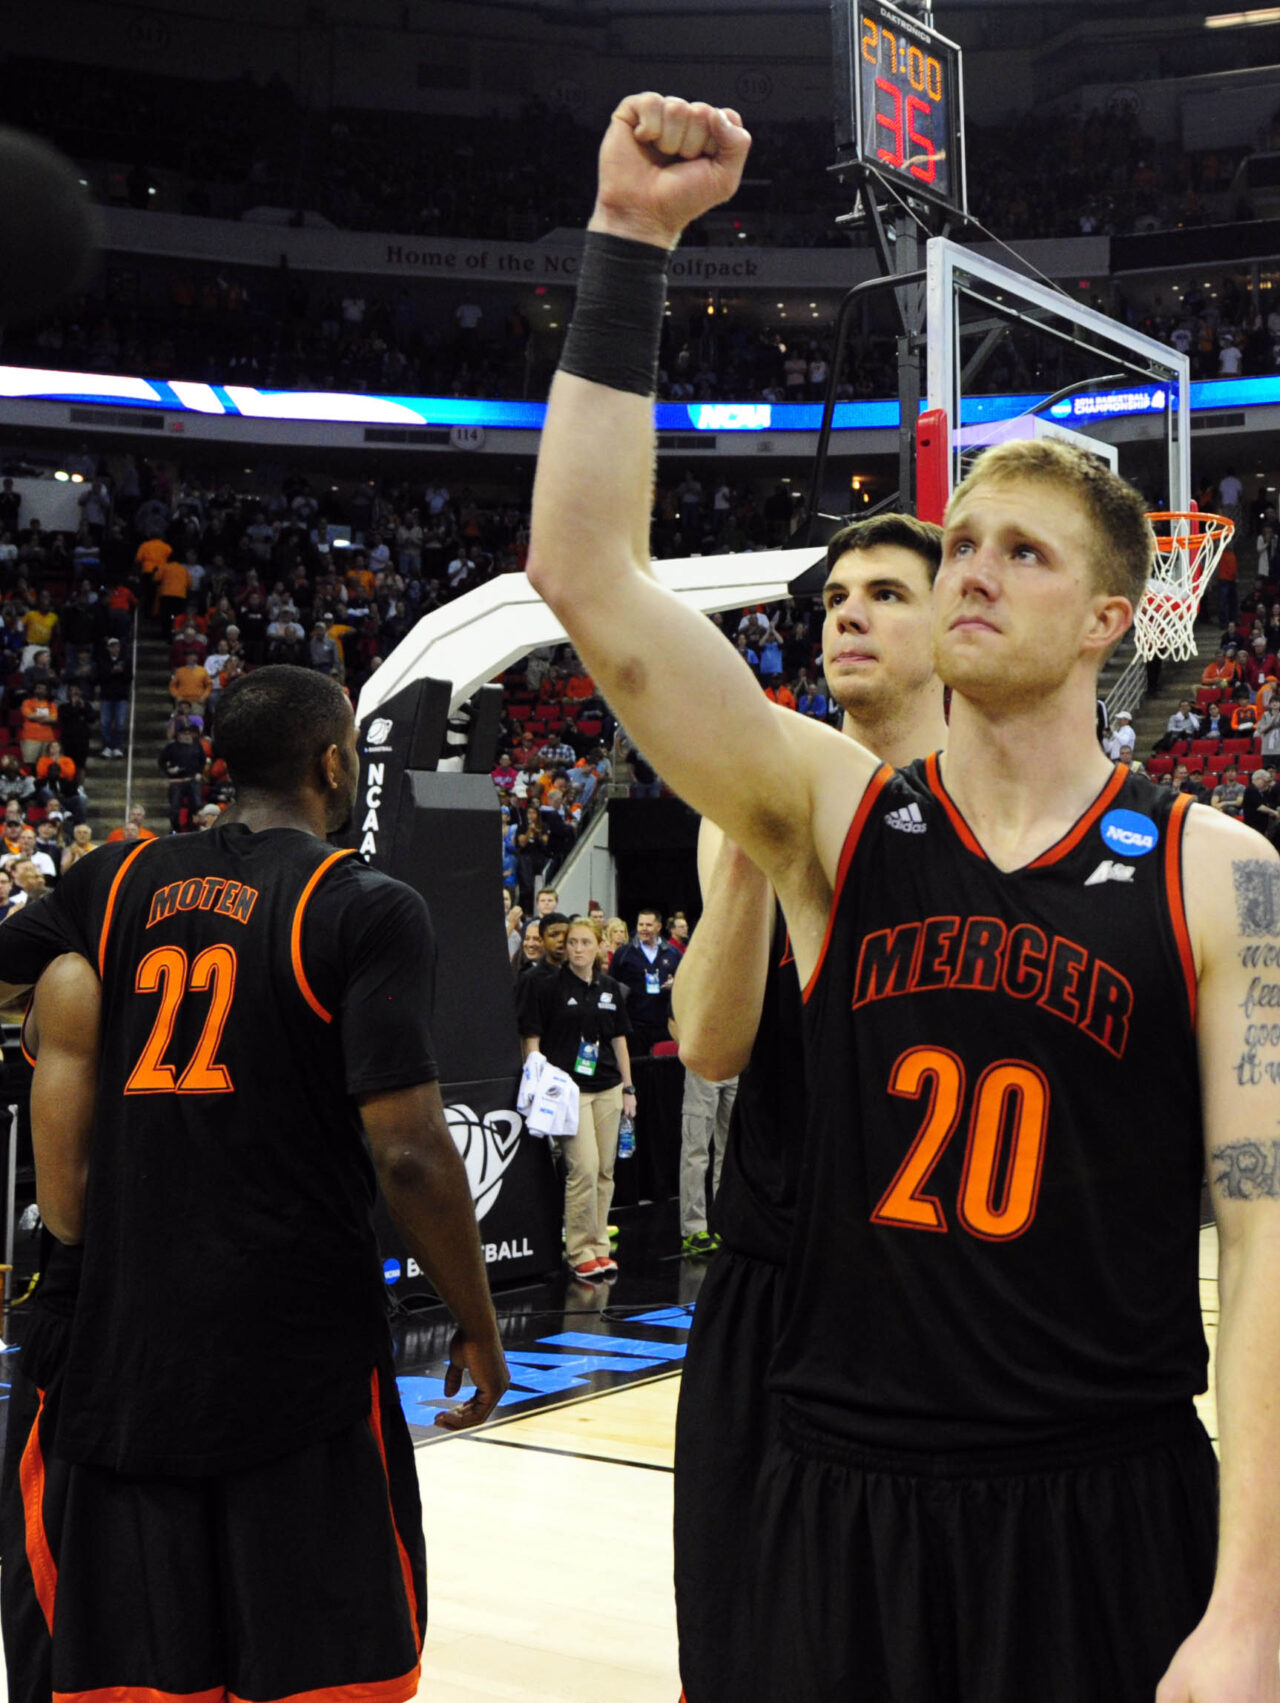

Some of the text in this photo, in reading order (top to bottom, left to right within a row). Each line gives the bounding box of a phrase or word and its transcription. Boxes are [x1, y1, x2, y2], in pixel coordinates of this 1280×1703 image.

[879, 8, 932, 44] DAKTRONICS
[861, 17, 943, 102] 27:00
[876, 77, 936, 184] 35
[386, 246, 457, 266] Home
[466, 250, 490, 271] of
[498, 252, 534, 272] the
[543, 256, 577, 274] NC
[457, 428, 478, 441] 114
[698, 403, 772, 429] NCAA
[884, 812, 928, 834] adidas
[1105, 824, 1154, 849] NCAA
[146, 876, 258, 930] MOTEN
[852, 915, 1134, 1059] MERCER
[124, 942, 237, 1095] 22
[870, 1045, 1051, 1242] 20
